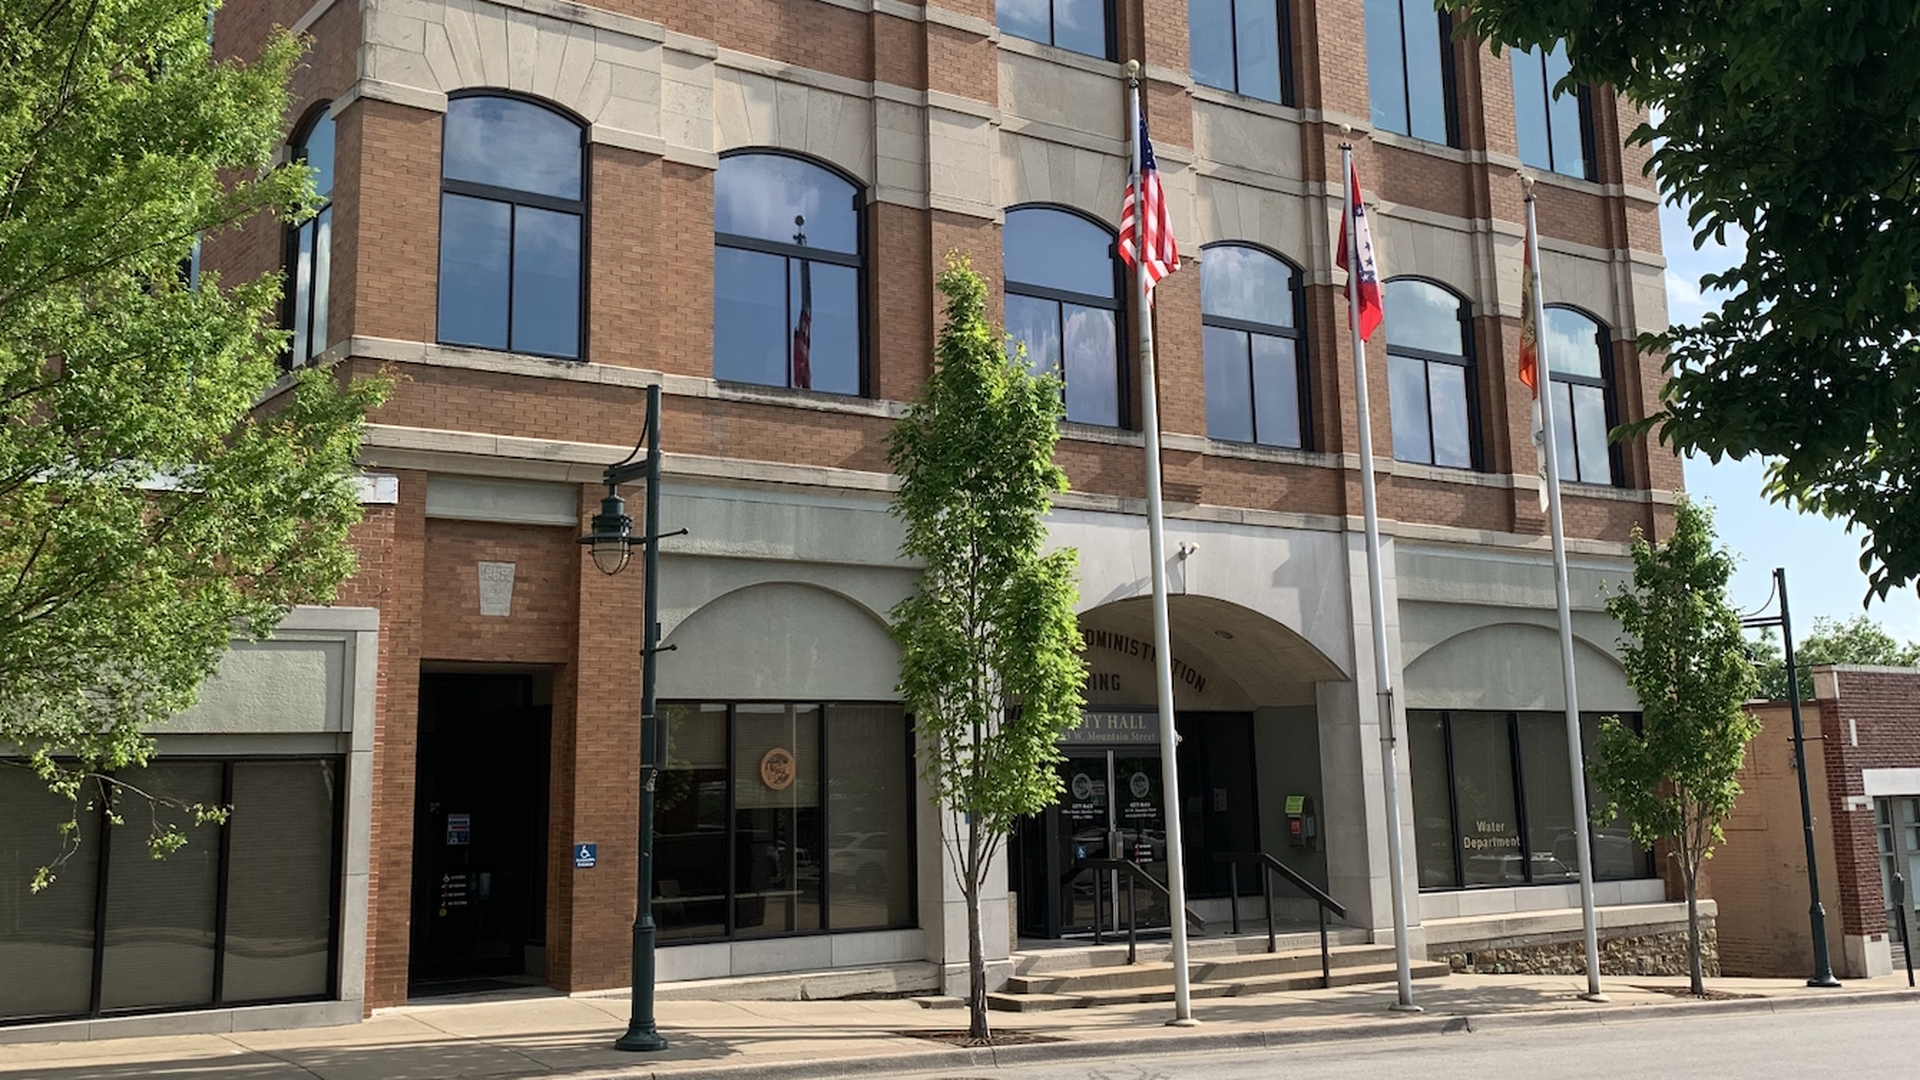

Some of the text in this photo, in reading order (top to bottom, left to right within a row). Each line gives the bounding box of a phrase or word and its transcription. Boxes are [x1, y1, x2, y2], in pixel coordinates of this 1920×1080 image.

[1083, 628, 1206, 693] DMINISTTION
[1107, 715, 1147, 730] HALL
[1088, 732, 1129, 741] Mountain
[1131, 731, 1156, 741] Street
[1476, 821, 1505, 833] Water
[1463, 836, 1521, 850] Department
